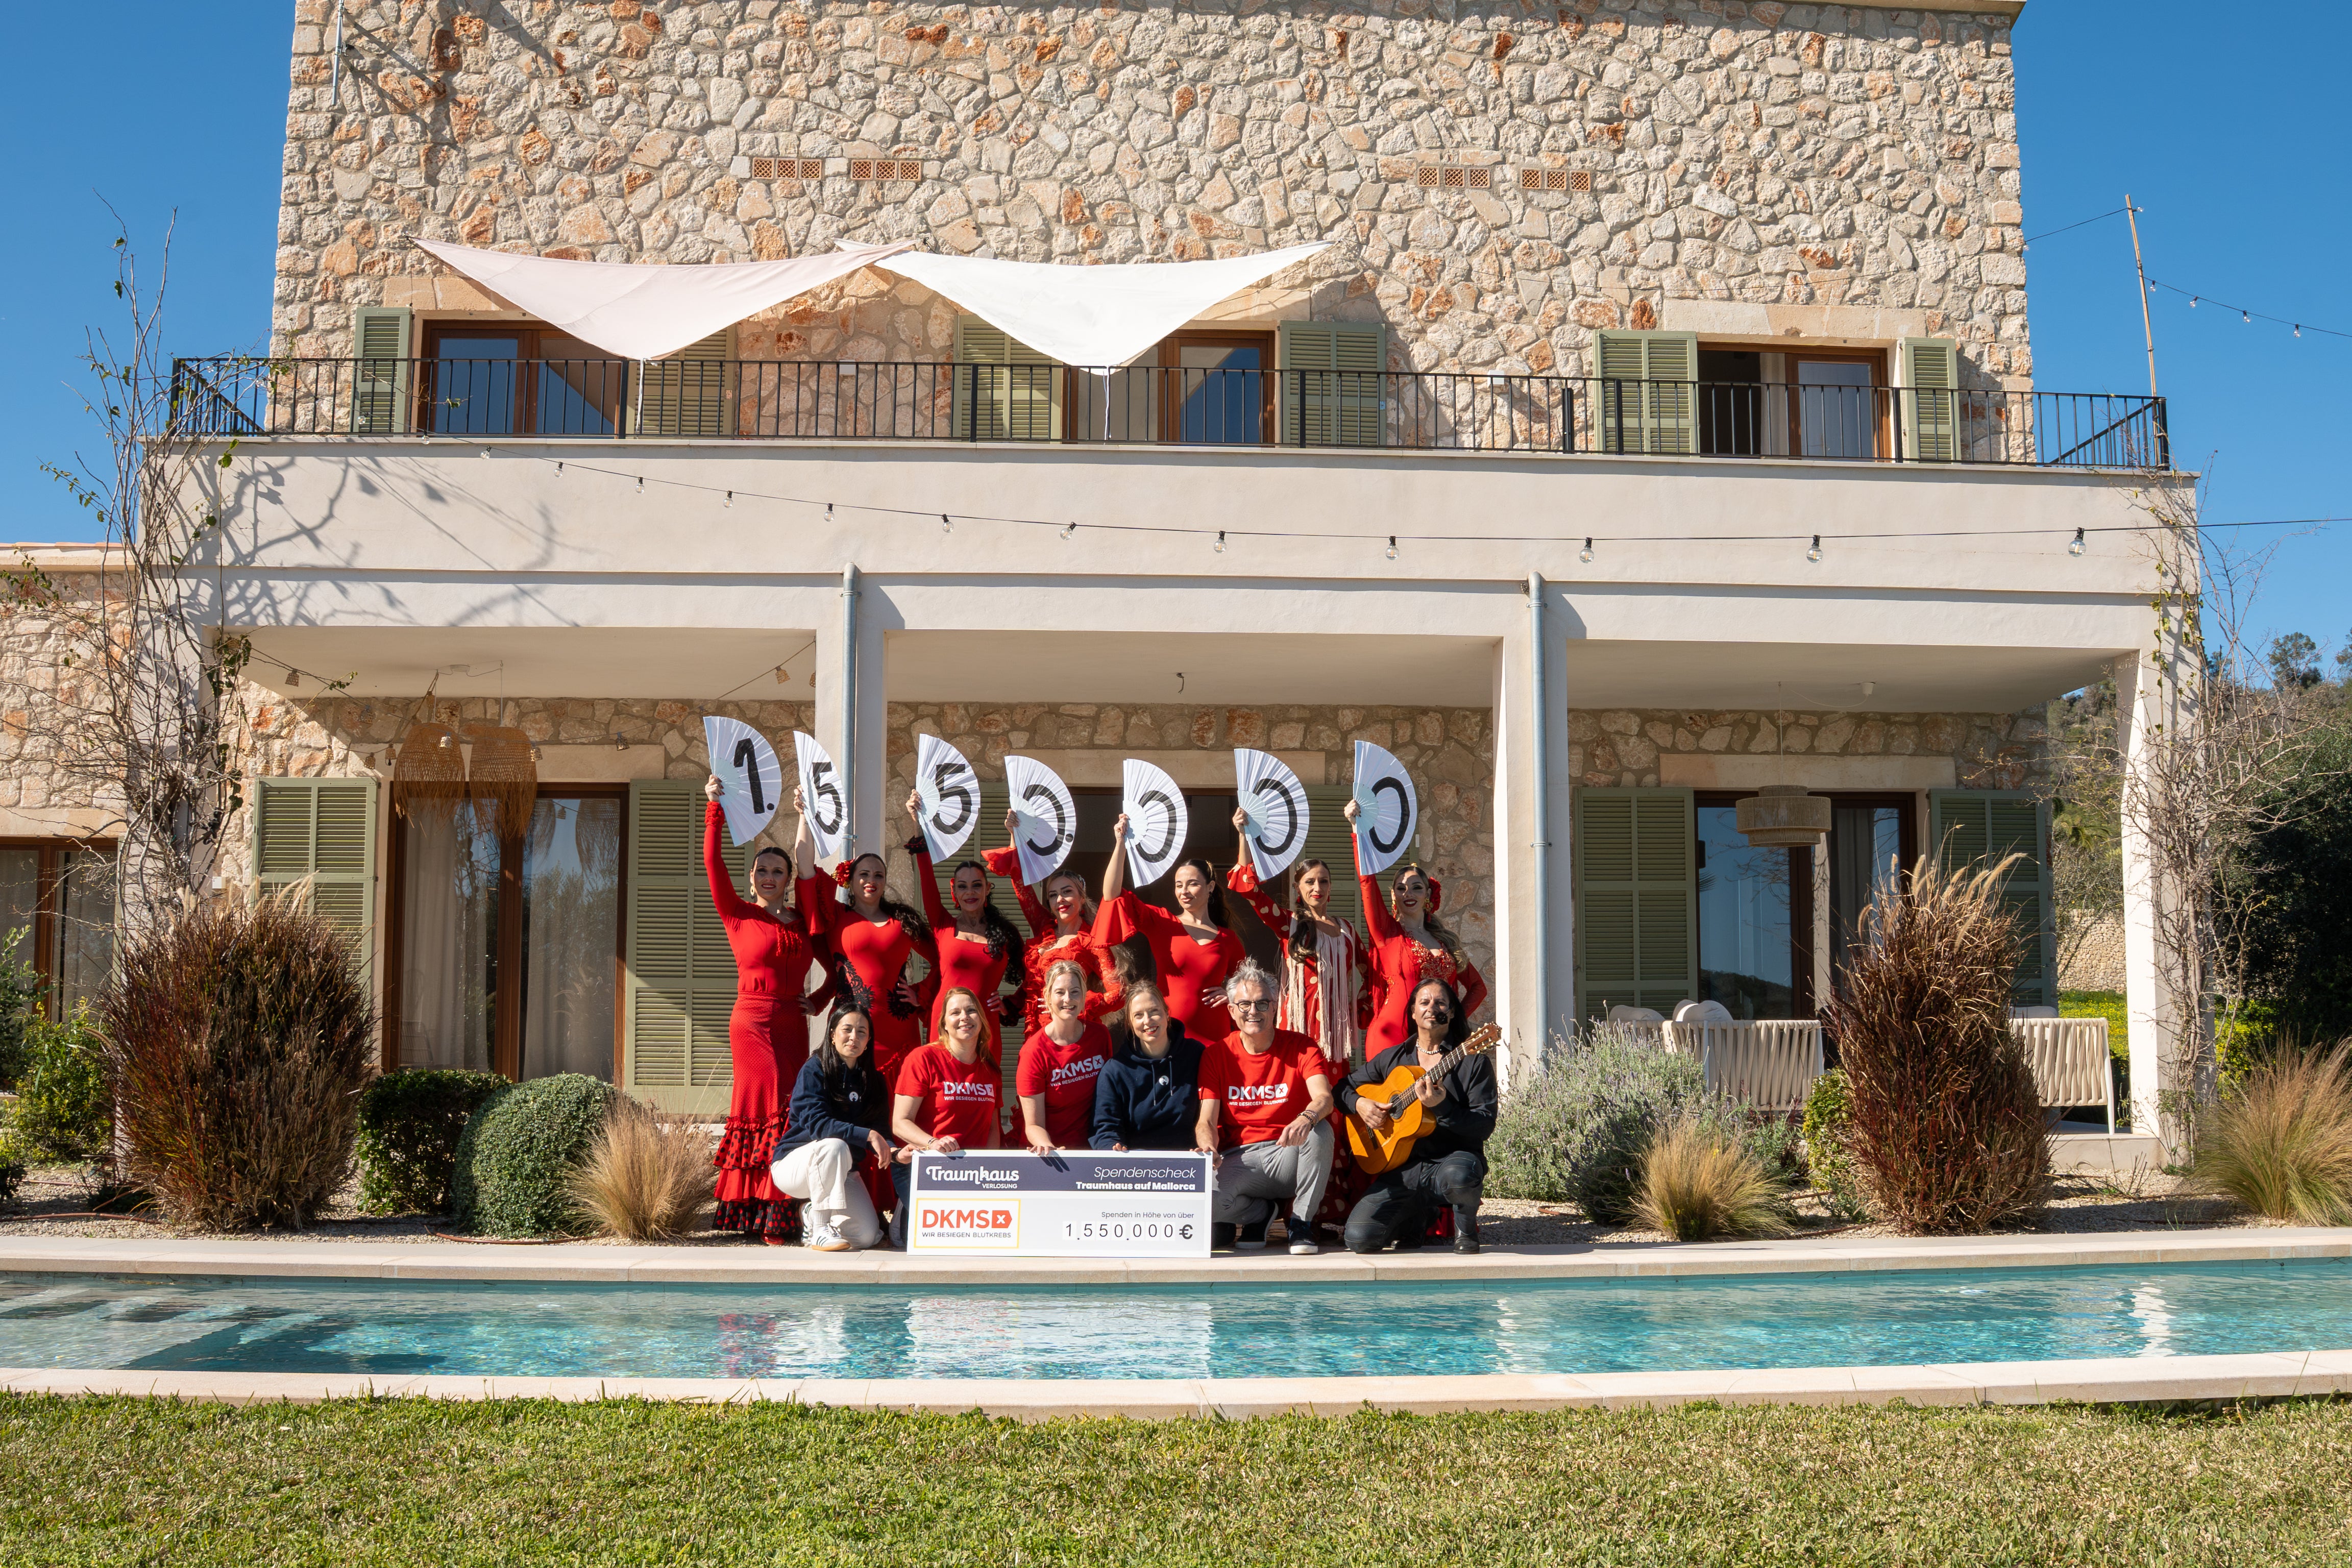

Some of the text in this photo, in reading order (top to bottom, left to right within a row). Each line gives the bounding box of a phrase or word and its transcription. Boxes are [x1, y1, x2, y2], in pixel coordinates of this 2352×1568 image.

[813, 762, 842, 835] 5
[933, 763, 973, 835] 5
[1051, 1058, 1093, 1082] DKMS
[943, 1081, 987, 1095] DKMS
[1062, 1075, 1085, 1085] BESIEGEN
[1228, 1085, 1275, 1100] DKMS
[925, 1166, 1019, 1185] Traumhaus
[1094, 1166, 1196, 1181] Spendenscheck
[1075, 1181, 1195, 1190] Traumhaus auf Mallorca
[922, 1210, 990, 1229] DKMS
